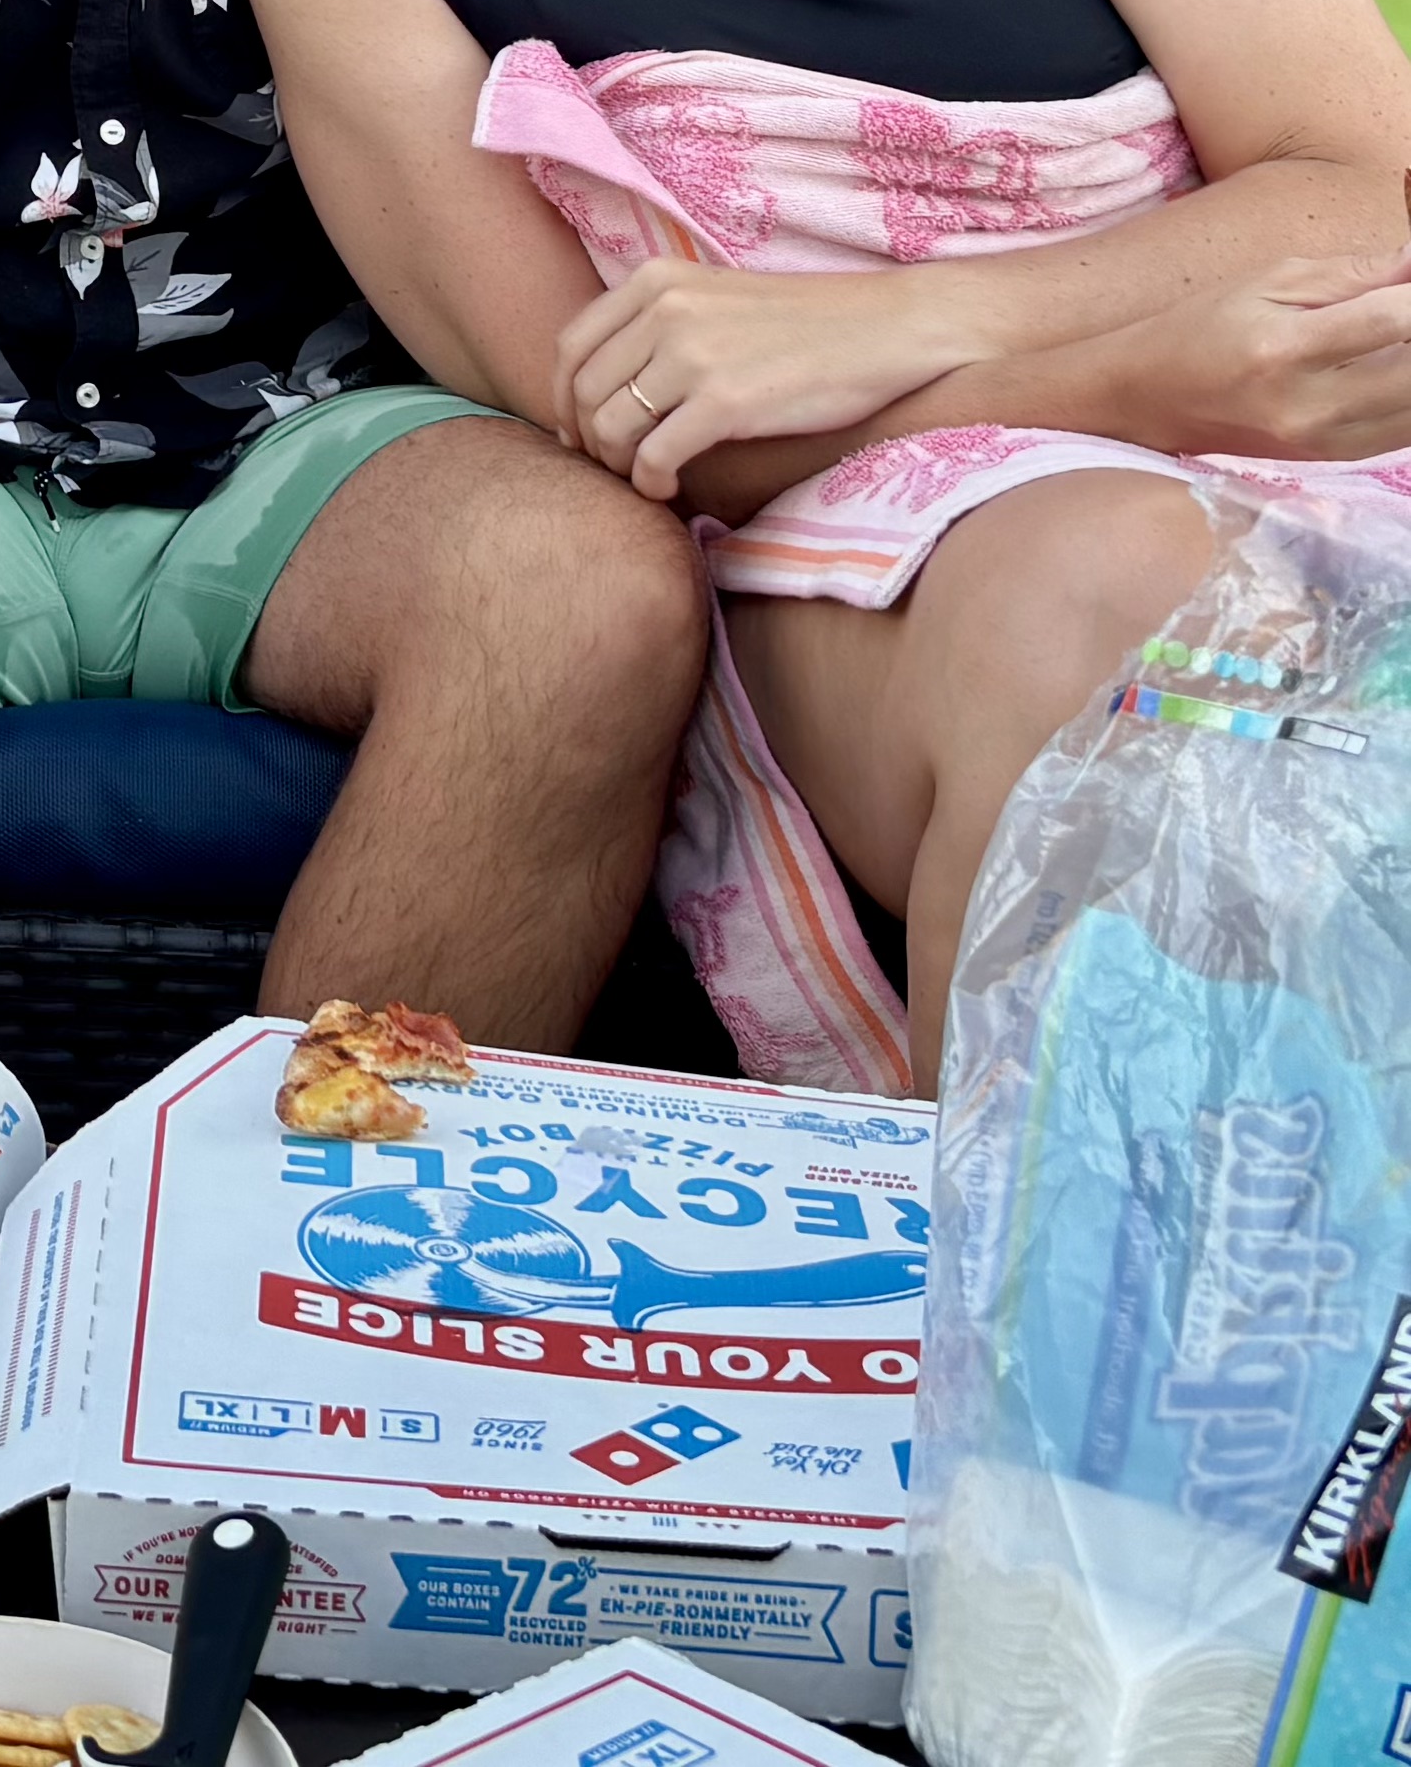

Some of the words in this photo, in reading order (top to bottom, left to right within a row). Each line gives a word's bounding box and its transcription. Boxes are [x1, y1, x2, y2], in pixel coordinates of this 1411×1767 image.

[293, 1285, 546, 1362] SLICE
[581, 1333, 833, 1384] YOUR
[319, 1404, 367, 1439] M
[113, 1575, 170, 1599] OUR
[417, 1580, 449, 1594] OUR
[452, 1582, 501, 1597] BOXES
[618, 1584, 639, 1596] WE
[644, 1585, 679, 1599] TAKE
[684, 1587, 727, 1602] PRIDE
[733, 1591, 749, 1604] IN
[754, 1593, 798, 1608] BEING
[427, 1595, 491, 1611] CONTAIN
[599, 1597, 813, 1629] EN-PIE-RONMENTALLY
[277, 1620, 327, 1636] RIGHT
[508, 1615, 587, 1633] RECYCLED
[658, 1619, 751, 1641] FRIENDLY
[508, 1631, 585, 1648] CONTENT
